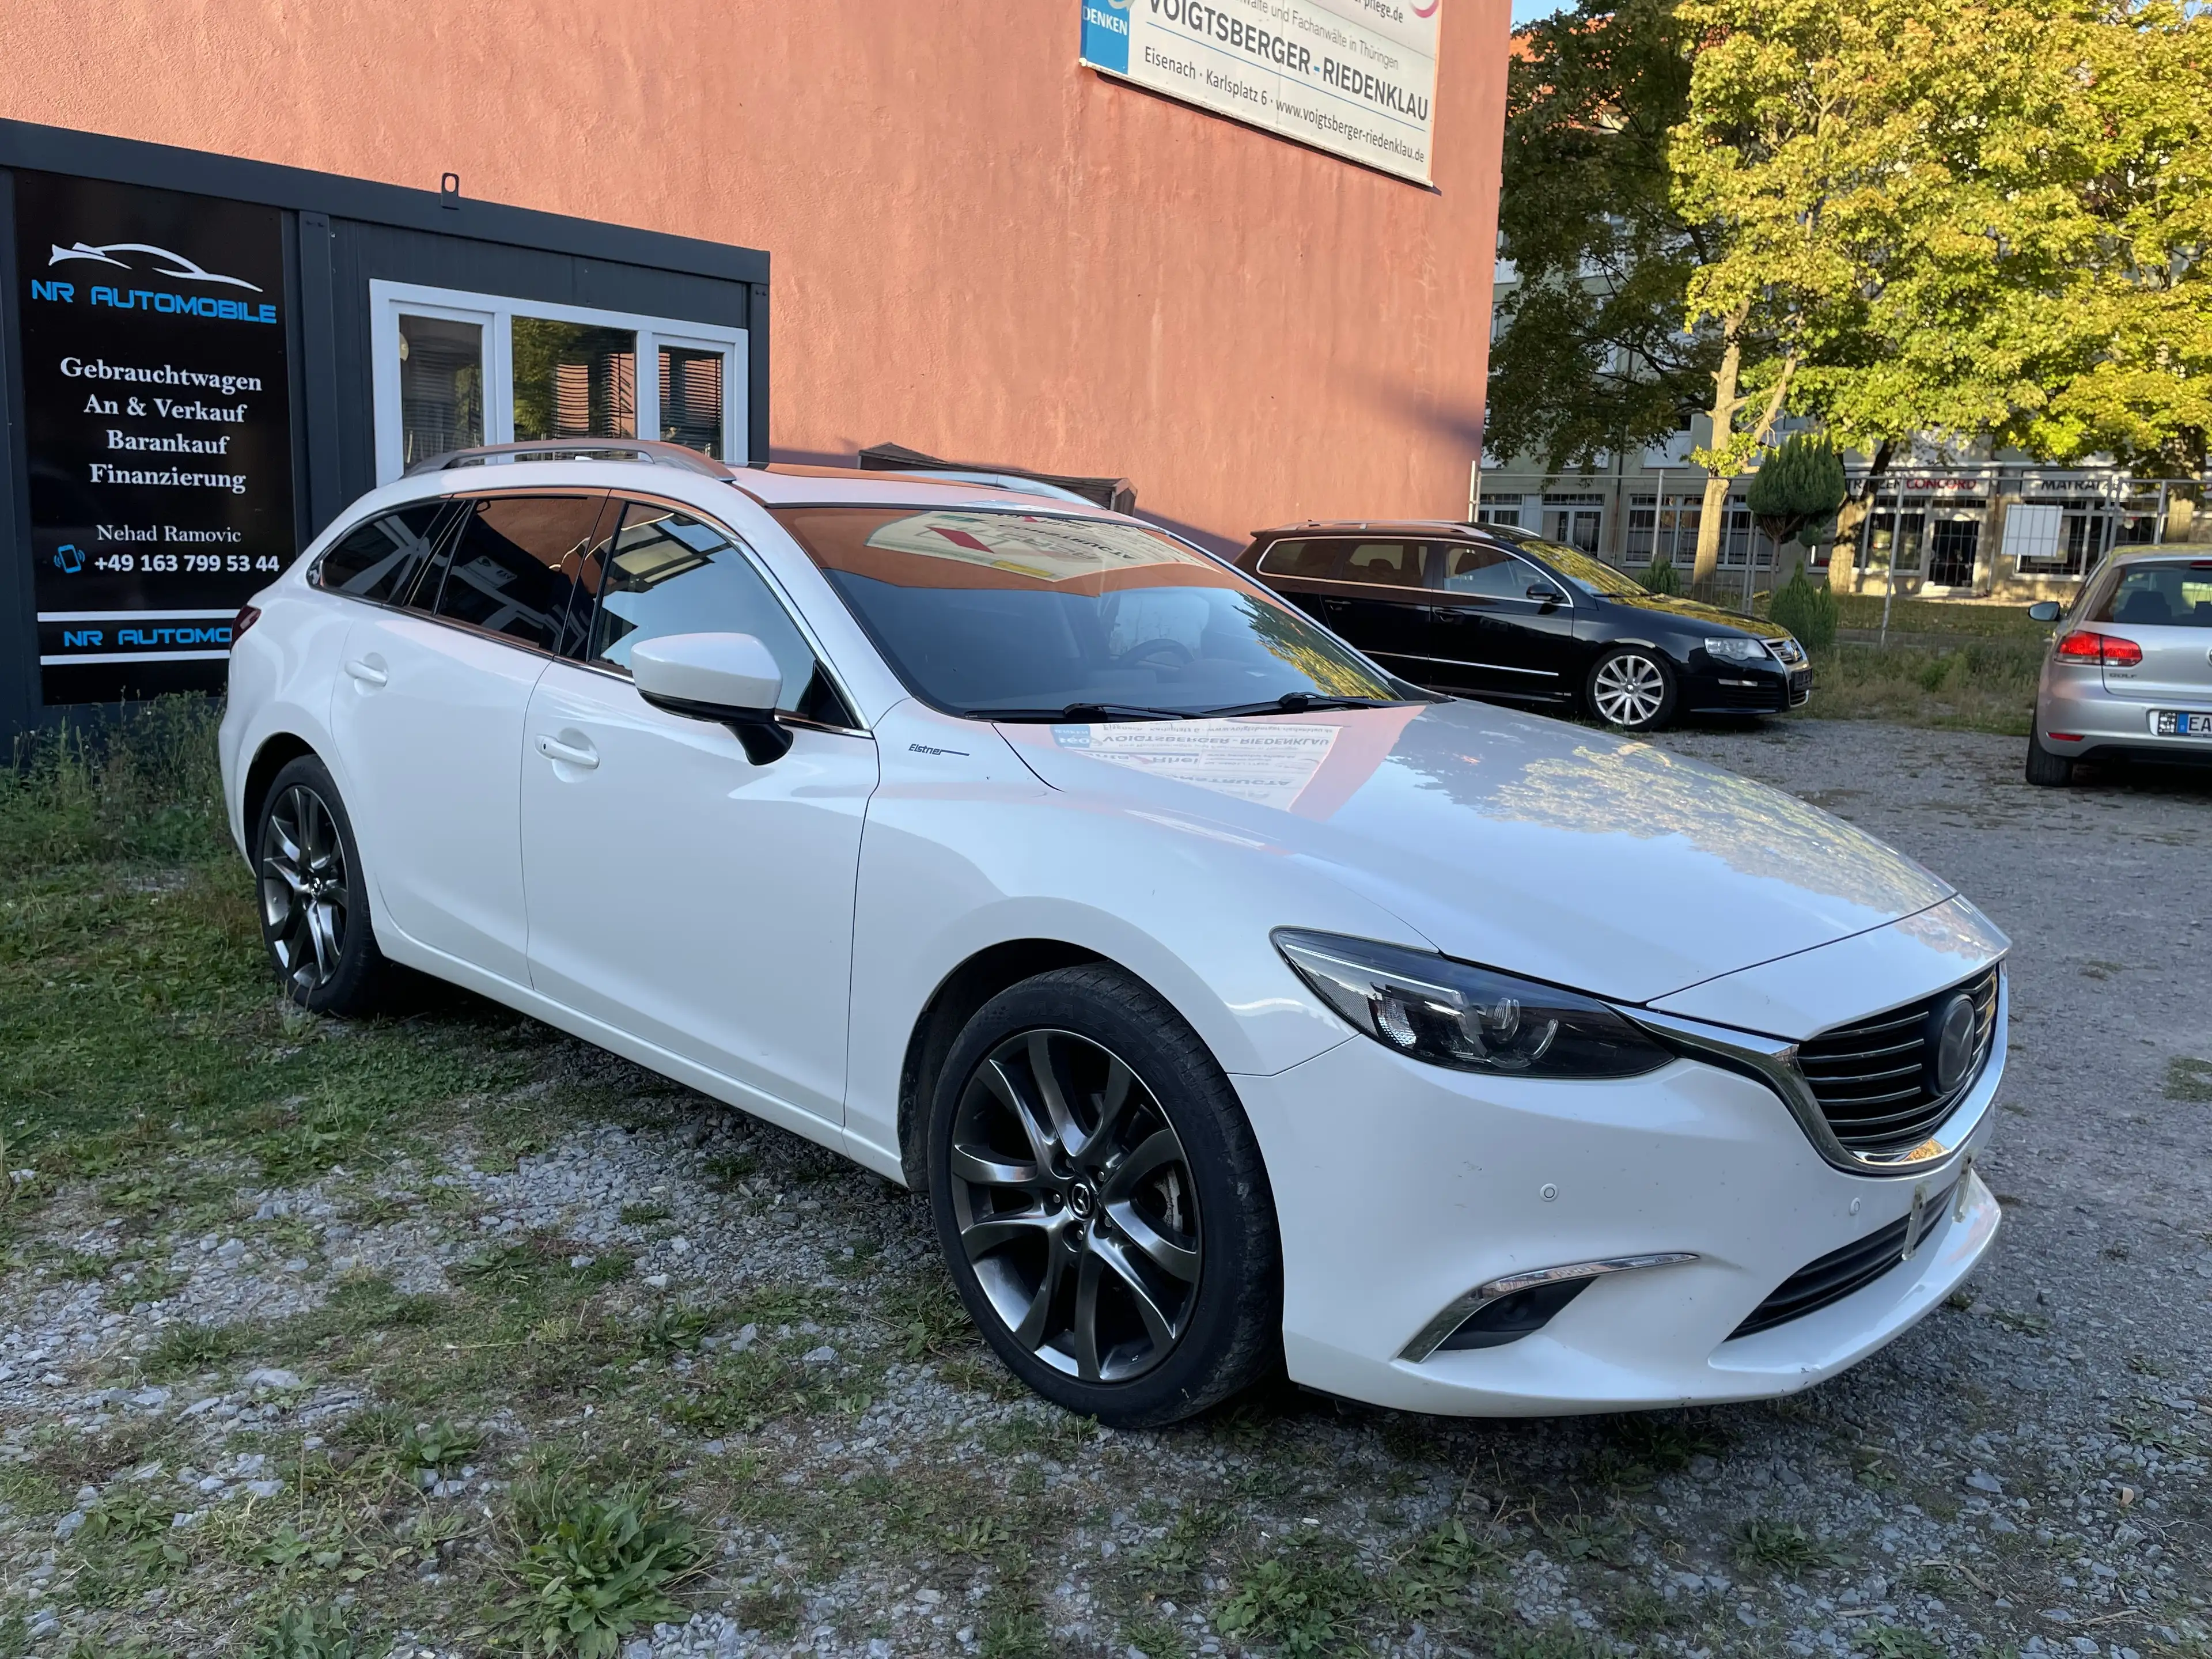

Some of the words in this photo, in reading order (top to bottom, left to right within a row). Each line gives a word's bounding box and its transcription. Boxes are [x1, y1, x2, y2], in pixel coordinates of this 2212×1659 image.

[1082, 5, 1128, 36] DENKEN
[1271, 5, 1289, 22] und
[1291, 10, 1347, 47] Fachanwälte
[1349, 35, 1357, 52] in
[1359, 39, 1399, 70] Thüringen
[1145, 46, 1196, 80] Eisenach
[1206, 69, 1258, 103] Karlsplatz
[1260, 90, 1267, 105] 6
[1275, 99, 1425, 163] www.voigtsberger-riedenklau.de
[31, 279, 75, 303] NR
[90, 286, 277, 324] AUTOMOBILE
[60, 357, 263, 395] Gebrauchtwagen
[84, 394, 119, 415] An
[126, 396, 147, 417] &
[153, 397, 248, 423] Verkauf
[106, 429, 230, 454] Barankauf
[89, 463, 247, 494] Finanzierung
[1906, 479, 1976, 490] CONCORD
[96, 524, 157, 542] Nehad
[164, 525, 242, 543] Ramovic
[94, 554, 134, 572] +49
[141, 554, 178, 573] 163
[184, 554, 221, 573] 799
[226, 555, 251, 573] 53
[255, 555, 280, 573] 44
[64, 630, 103, 647] NR
[2189, 717, 2212, 732] EA
[908, 743, 970, 756] Elstner
